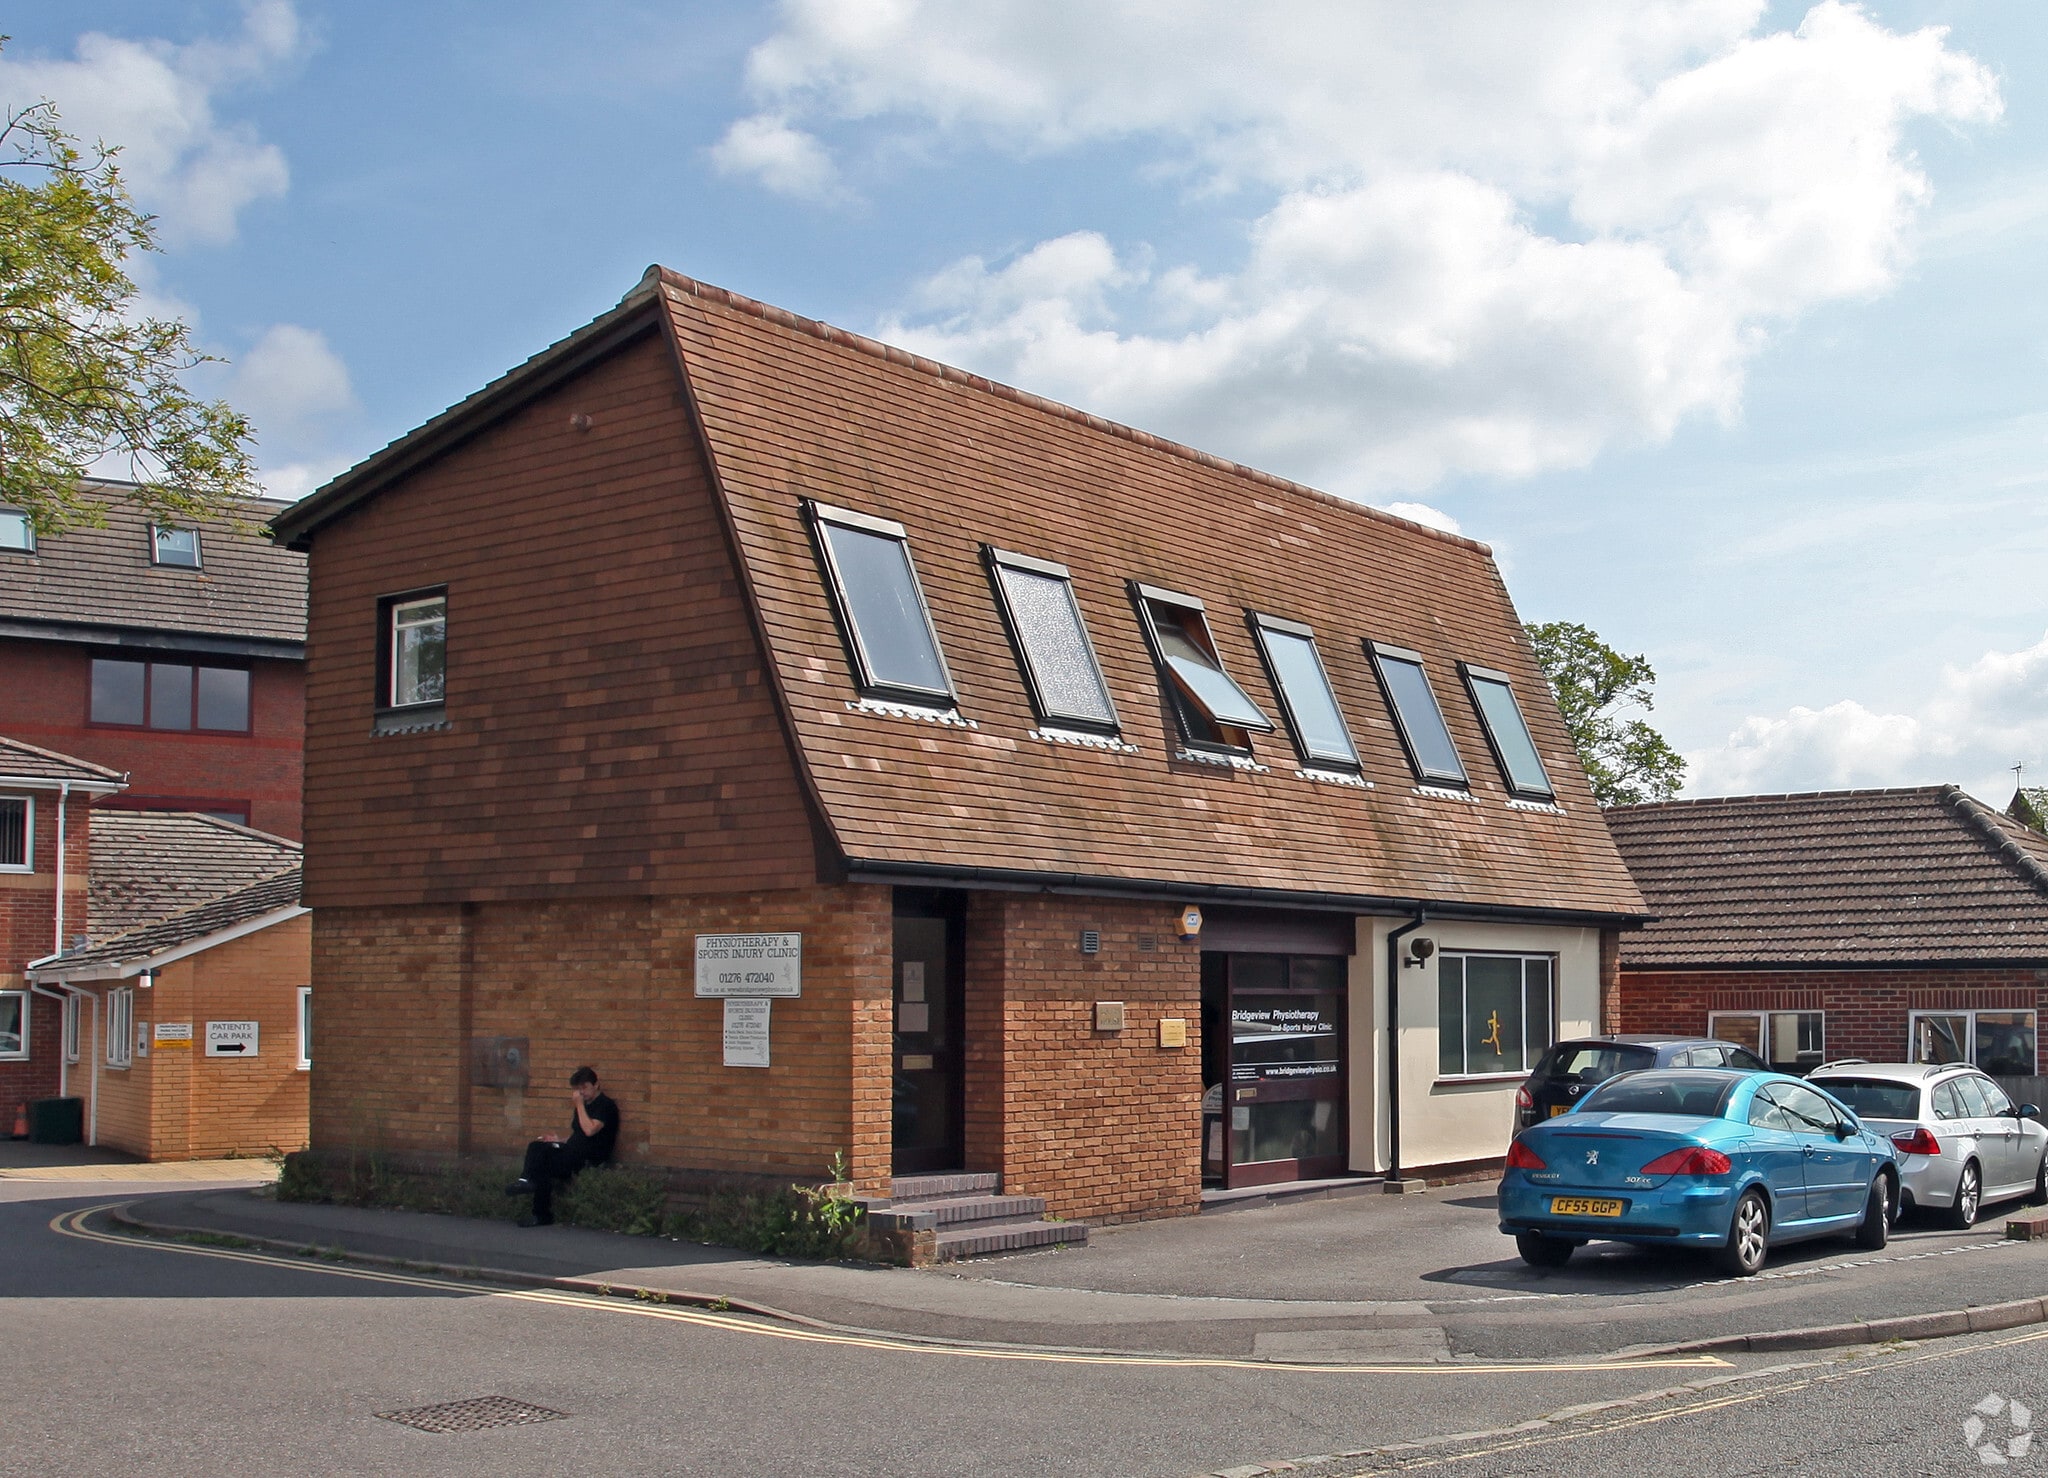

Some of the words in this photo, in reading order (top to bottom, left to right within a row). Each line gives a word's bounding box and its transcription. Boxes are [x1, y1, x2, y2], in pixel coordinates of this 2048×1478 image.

[706, 937, 780, 948] PHYSIOTHERAPY
[782, 936, 789, 946] &
[698, 949, 729, 959] SPORTS
[732, 948, 764, 959] INJURY
[767, 947, 798, 958] CLINIC
[718, 972, 742, 984] 01276
[745, 972, 775, 983] 472040
[1232, 1010, 1271, 1022] Bridgeview
[1272, 1010, 1320, 1021] Physiotherapy
[212, 1023, 252, 1031] PATIENTS
[1283, 1024, 1301, 1032] Sports
[1302, 1023, 1317, 1032] Injury
[1317, 1022, 1333, 1031] Clinic
[210, 1032, 230, 1040] CAR
[231, 1032, 253, 1040] PARK
[1265, 1064, 1337, 1076] www.bridgeviewphysio.co.uk
[1556, 1199, 1589, 1212] CF55
[1591, 1201, 1617, 1214] GGP
